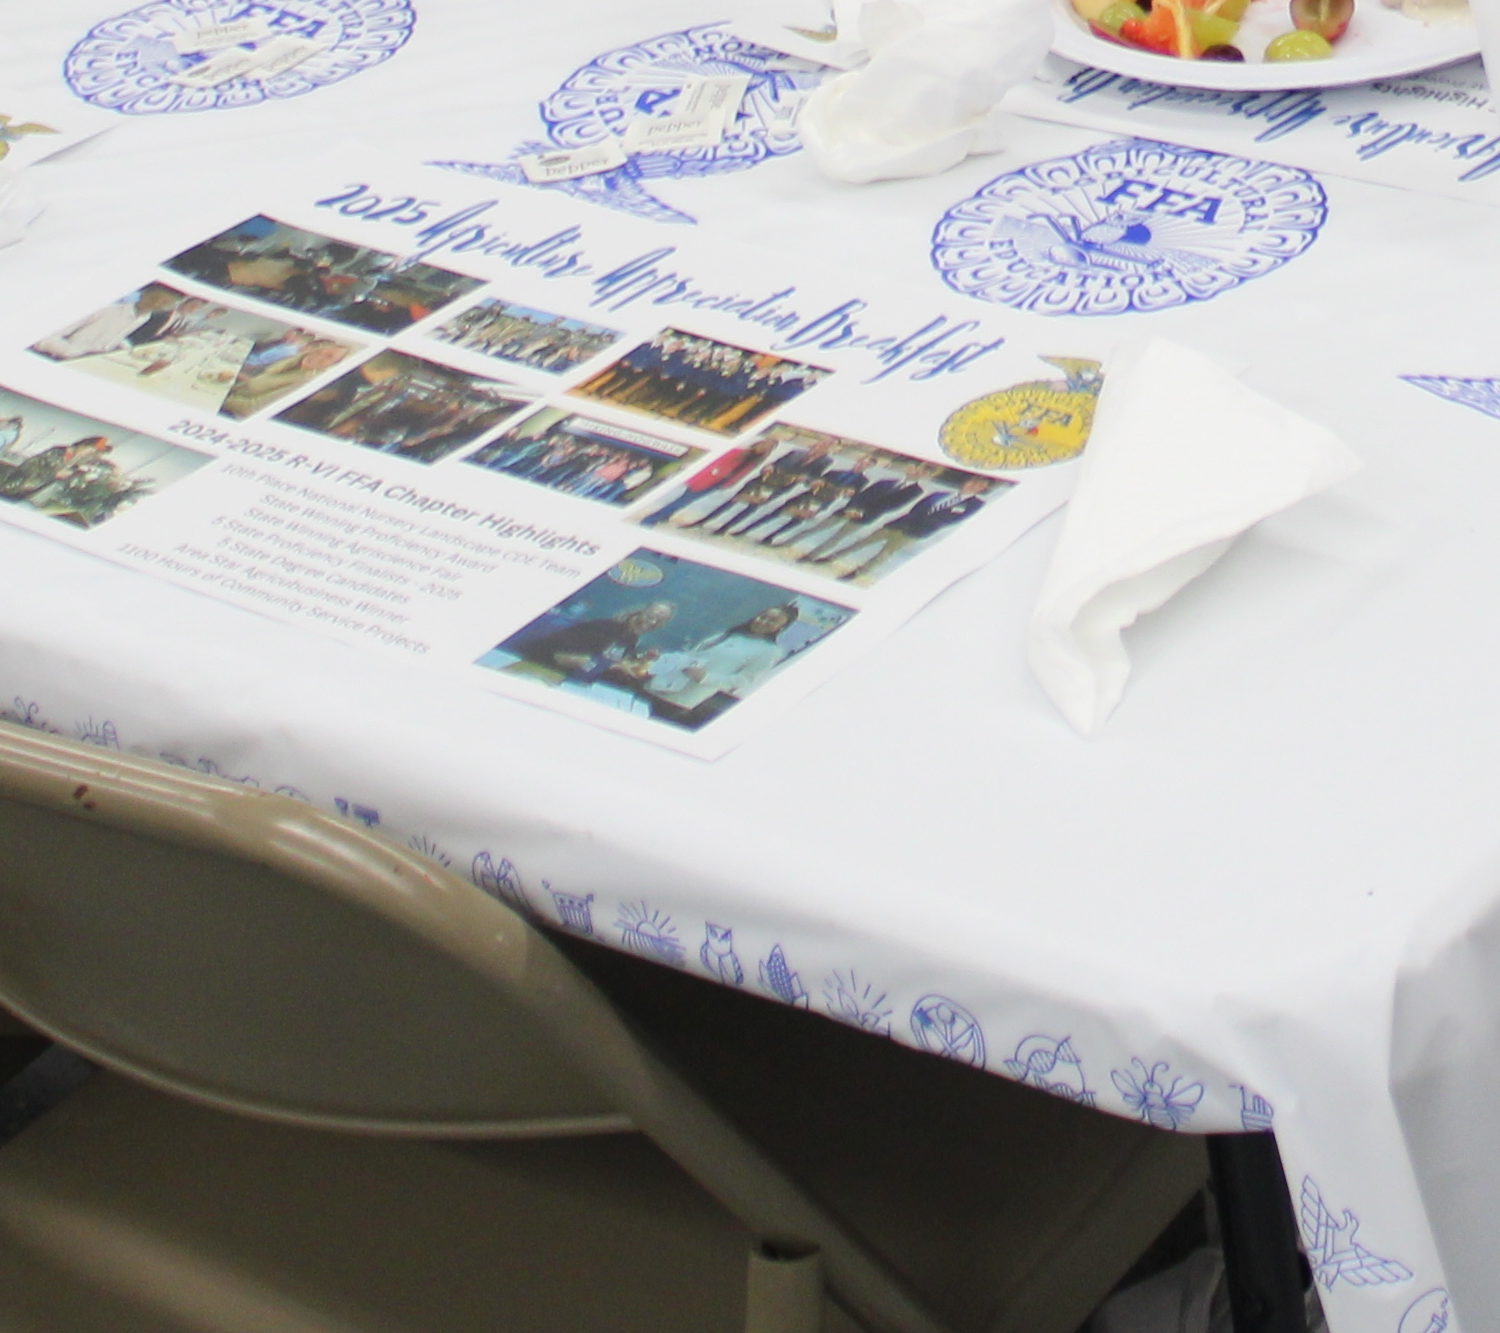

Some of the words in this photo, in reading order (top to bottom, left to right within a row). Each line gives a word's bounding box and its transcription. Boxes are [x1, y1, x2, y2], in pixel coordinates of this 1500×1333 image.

[220, 3, 327, 39] FFA
[1117, 75, 1328, 144] Appreciation
[1372, 81, 1488, 110] Highlights
[1097, 180, 1226, 225] FFA
[315, 184, 441, 225] 2025
[385, 199, 594, 283] Agriculture
[588, 246, 801, 333] Appreciation
[772, 298, 1006, 384] Breakfast
[990, 238, 1176, 288] EDUCATION
[1019, 400, 1074, 428] FFA
[167, 420, 290, 462] 2024-2025
[285, 454, 340, 478] R-VI
[336, 470, 384, 494] FFA
[383, 485, 481, 523] Chapter
[478, 513, 601, 557] Highlights
[220, 463, 256, 482] 10th
[256, 474, 297, 493] Place
[298, 486, 361, 516] National
[360, 507, 418, 533] Nursery
[418, 524, 502, 558] Landscape
[501, 549, 538, 567] CDE
[539, 559, 582, 579] Team
[223, 519, 265, 540] State
[265, 532, 347, 567] Proficiency
[349, 559, 412, 586] Finalists
[419, 582, 464, 603] 2025
[243, 507, 285, 527] State
[285, 520, 345, 549] Winning
[344, 538, 431, 574] Agriscience
[430, 564, 464, 583] Fair
[259, 494, 300, 514] State
[299, 506, 365, 535] Winning
[366, 524, 447, 561] Proficiency
[445, 551, 498, 574] Award
[116, 542, 160, 563] 1100
[156, 556, 202, 579] Hours
[201, 571, 223, 583] of
[220, 576, 305, 614] Community
[304, 602, 367, 632] Service
[365, 623, 432, 656] Projects
[173, 543, 209, 562] Area
[208, 554, 243, 572] Star
[352, 599, 411, 626] Winner
[229, 540, 271, 562] State
[270, 553, 326, 580] Degree
[324, 570, 411, 606] Candidates
